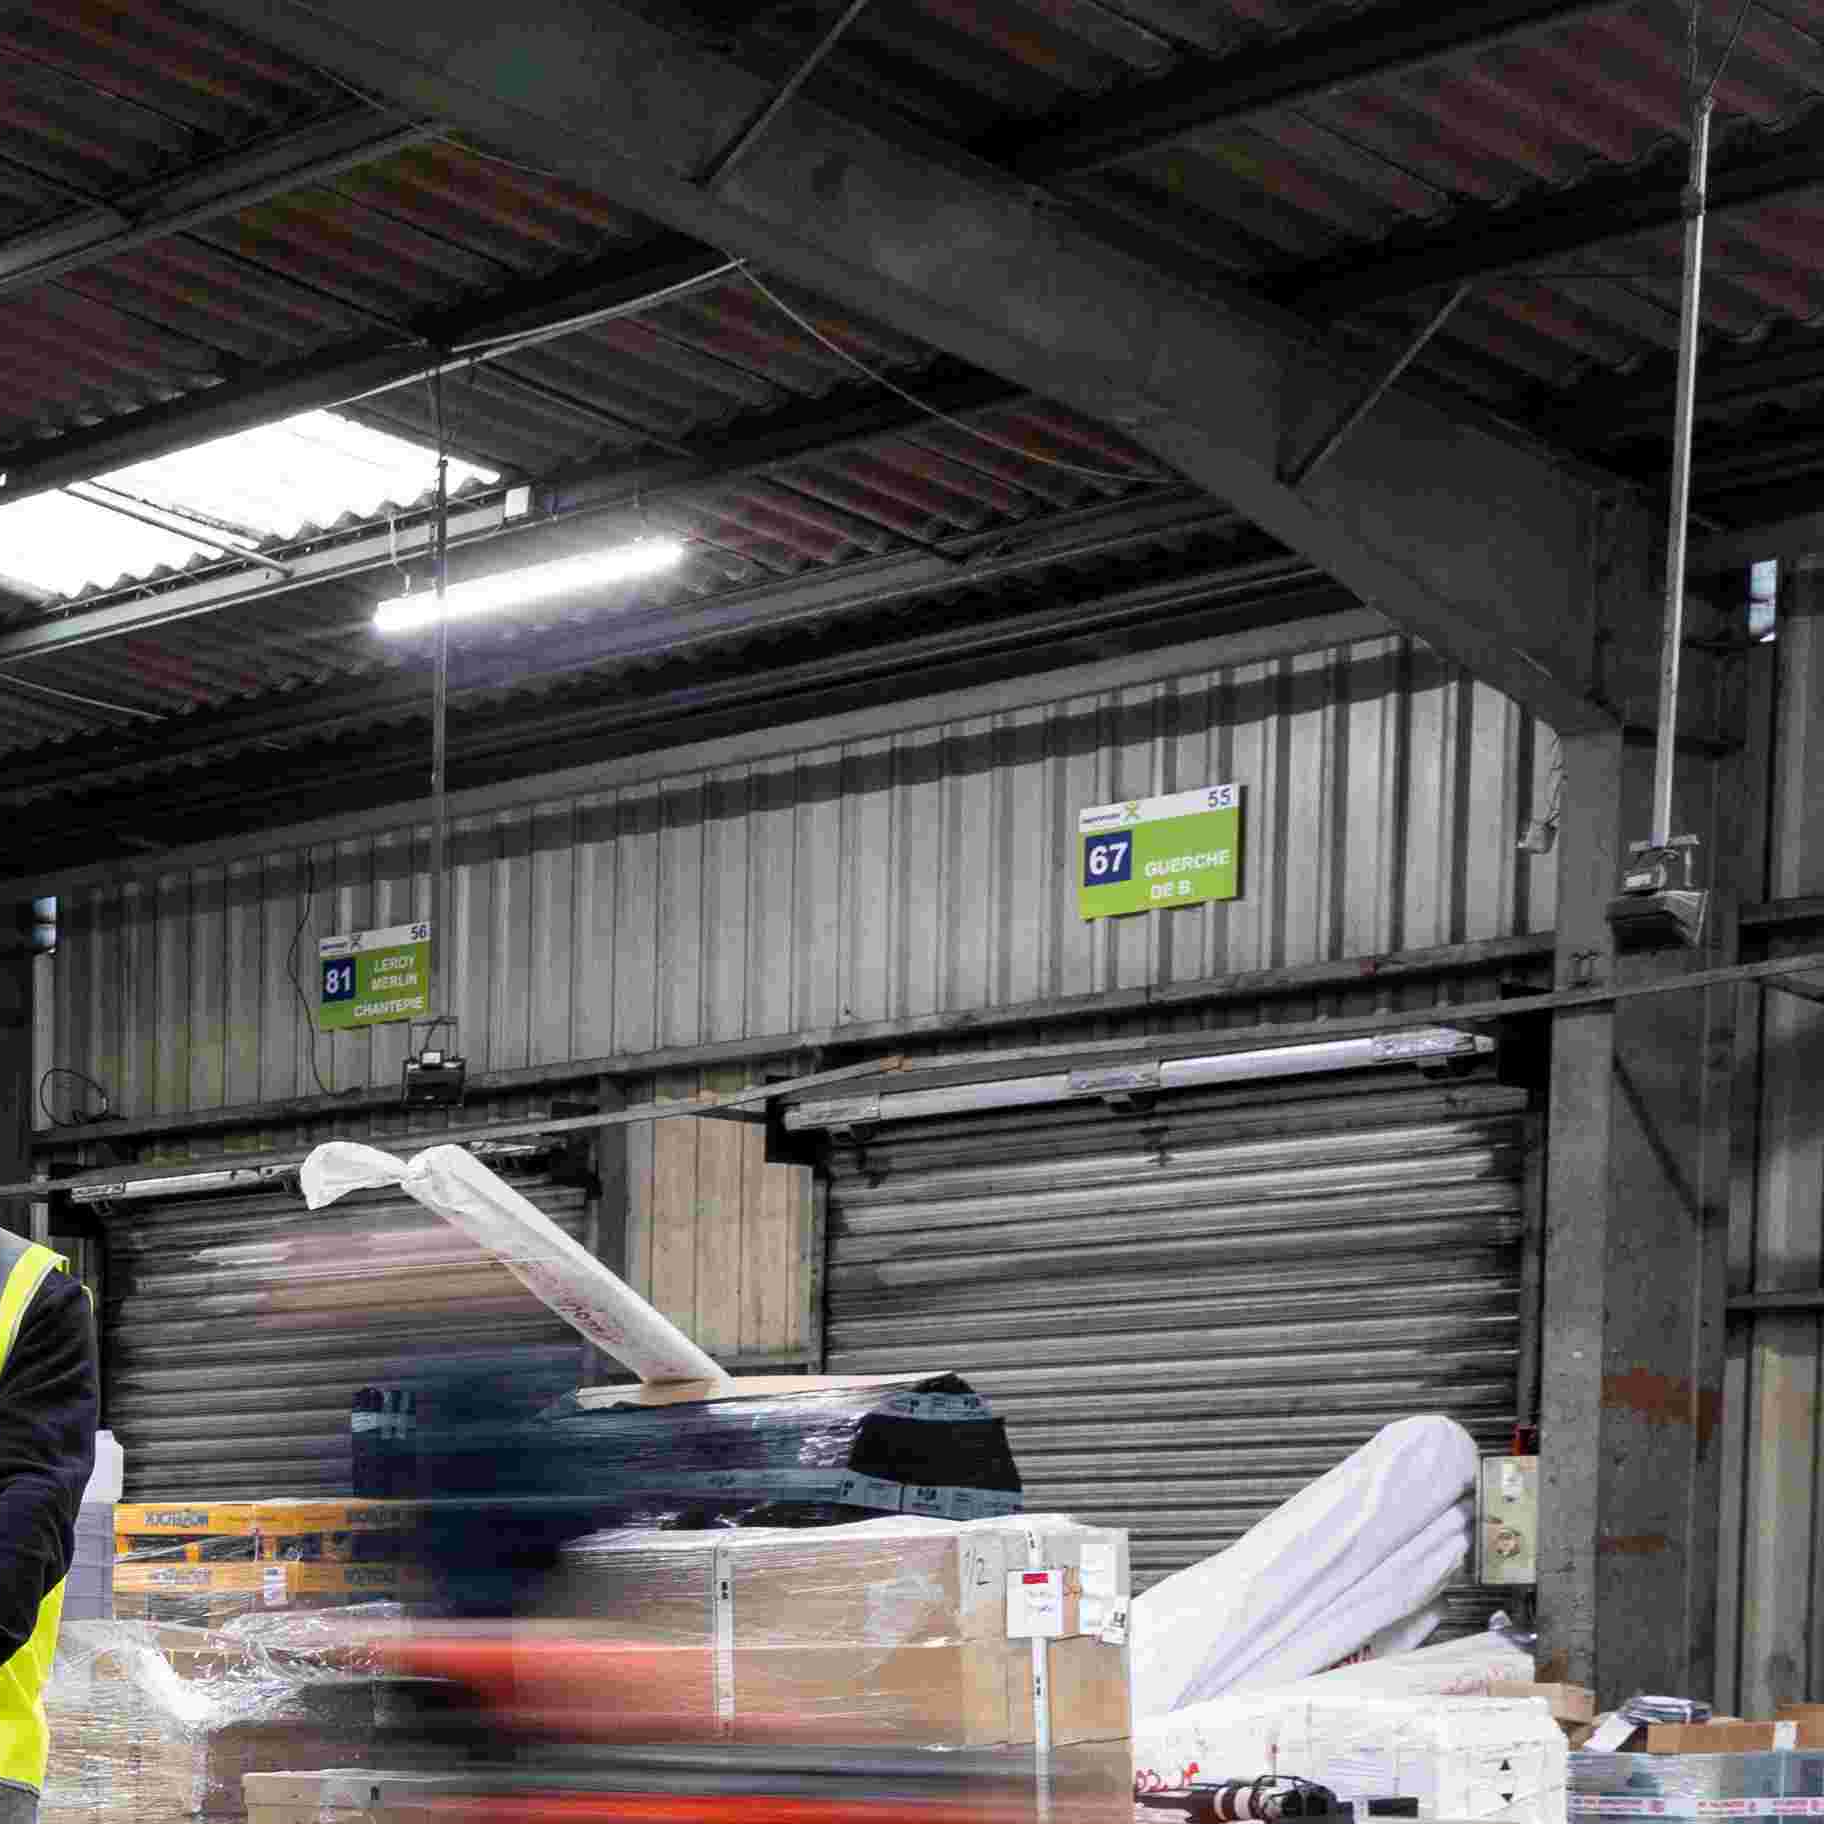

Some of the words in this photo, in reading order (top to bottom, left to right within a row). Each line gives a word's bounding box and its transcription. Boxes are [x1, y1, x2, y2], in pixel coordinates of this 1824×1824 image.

[1207, 787, 1232, 808] 55
[1088, 842, 1129, 876] 67
[324, 966, 353, 994] 81
